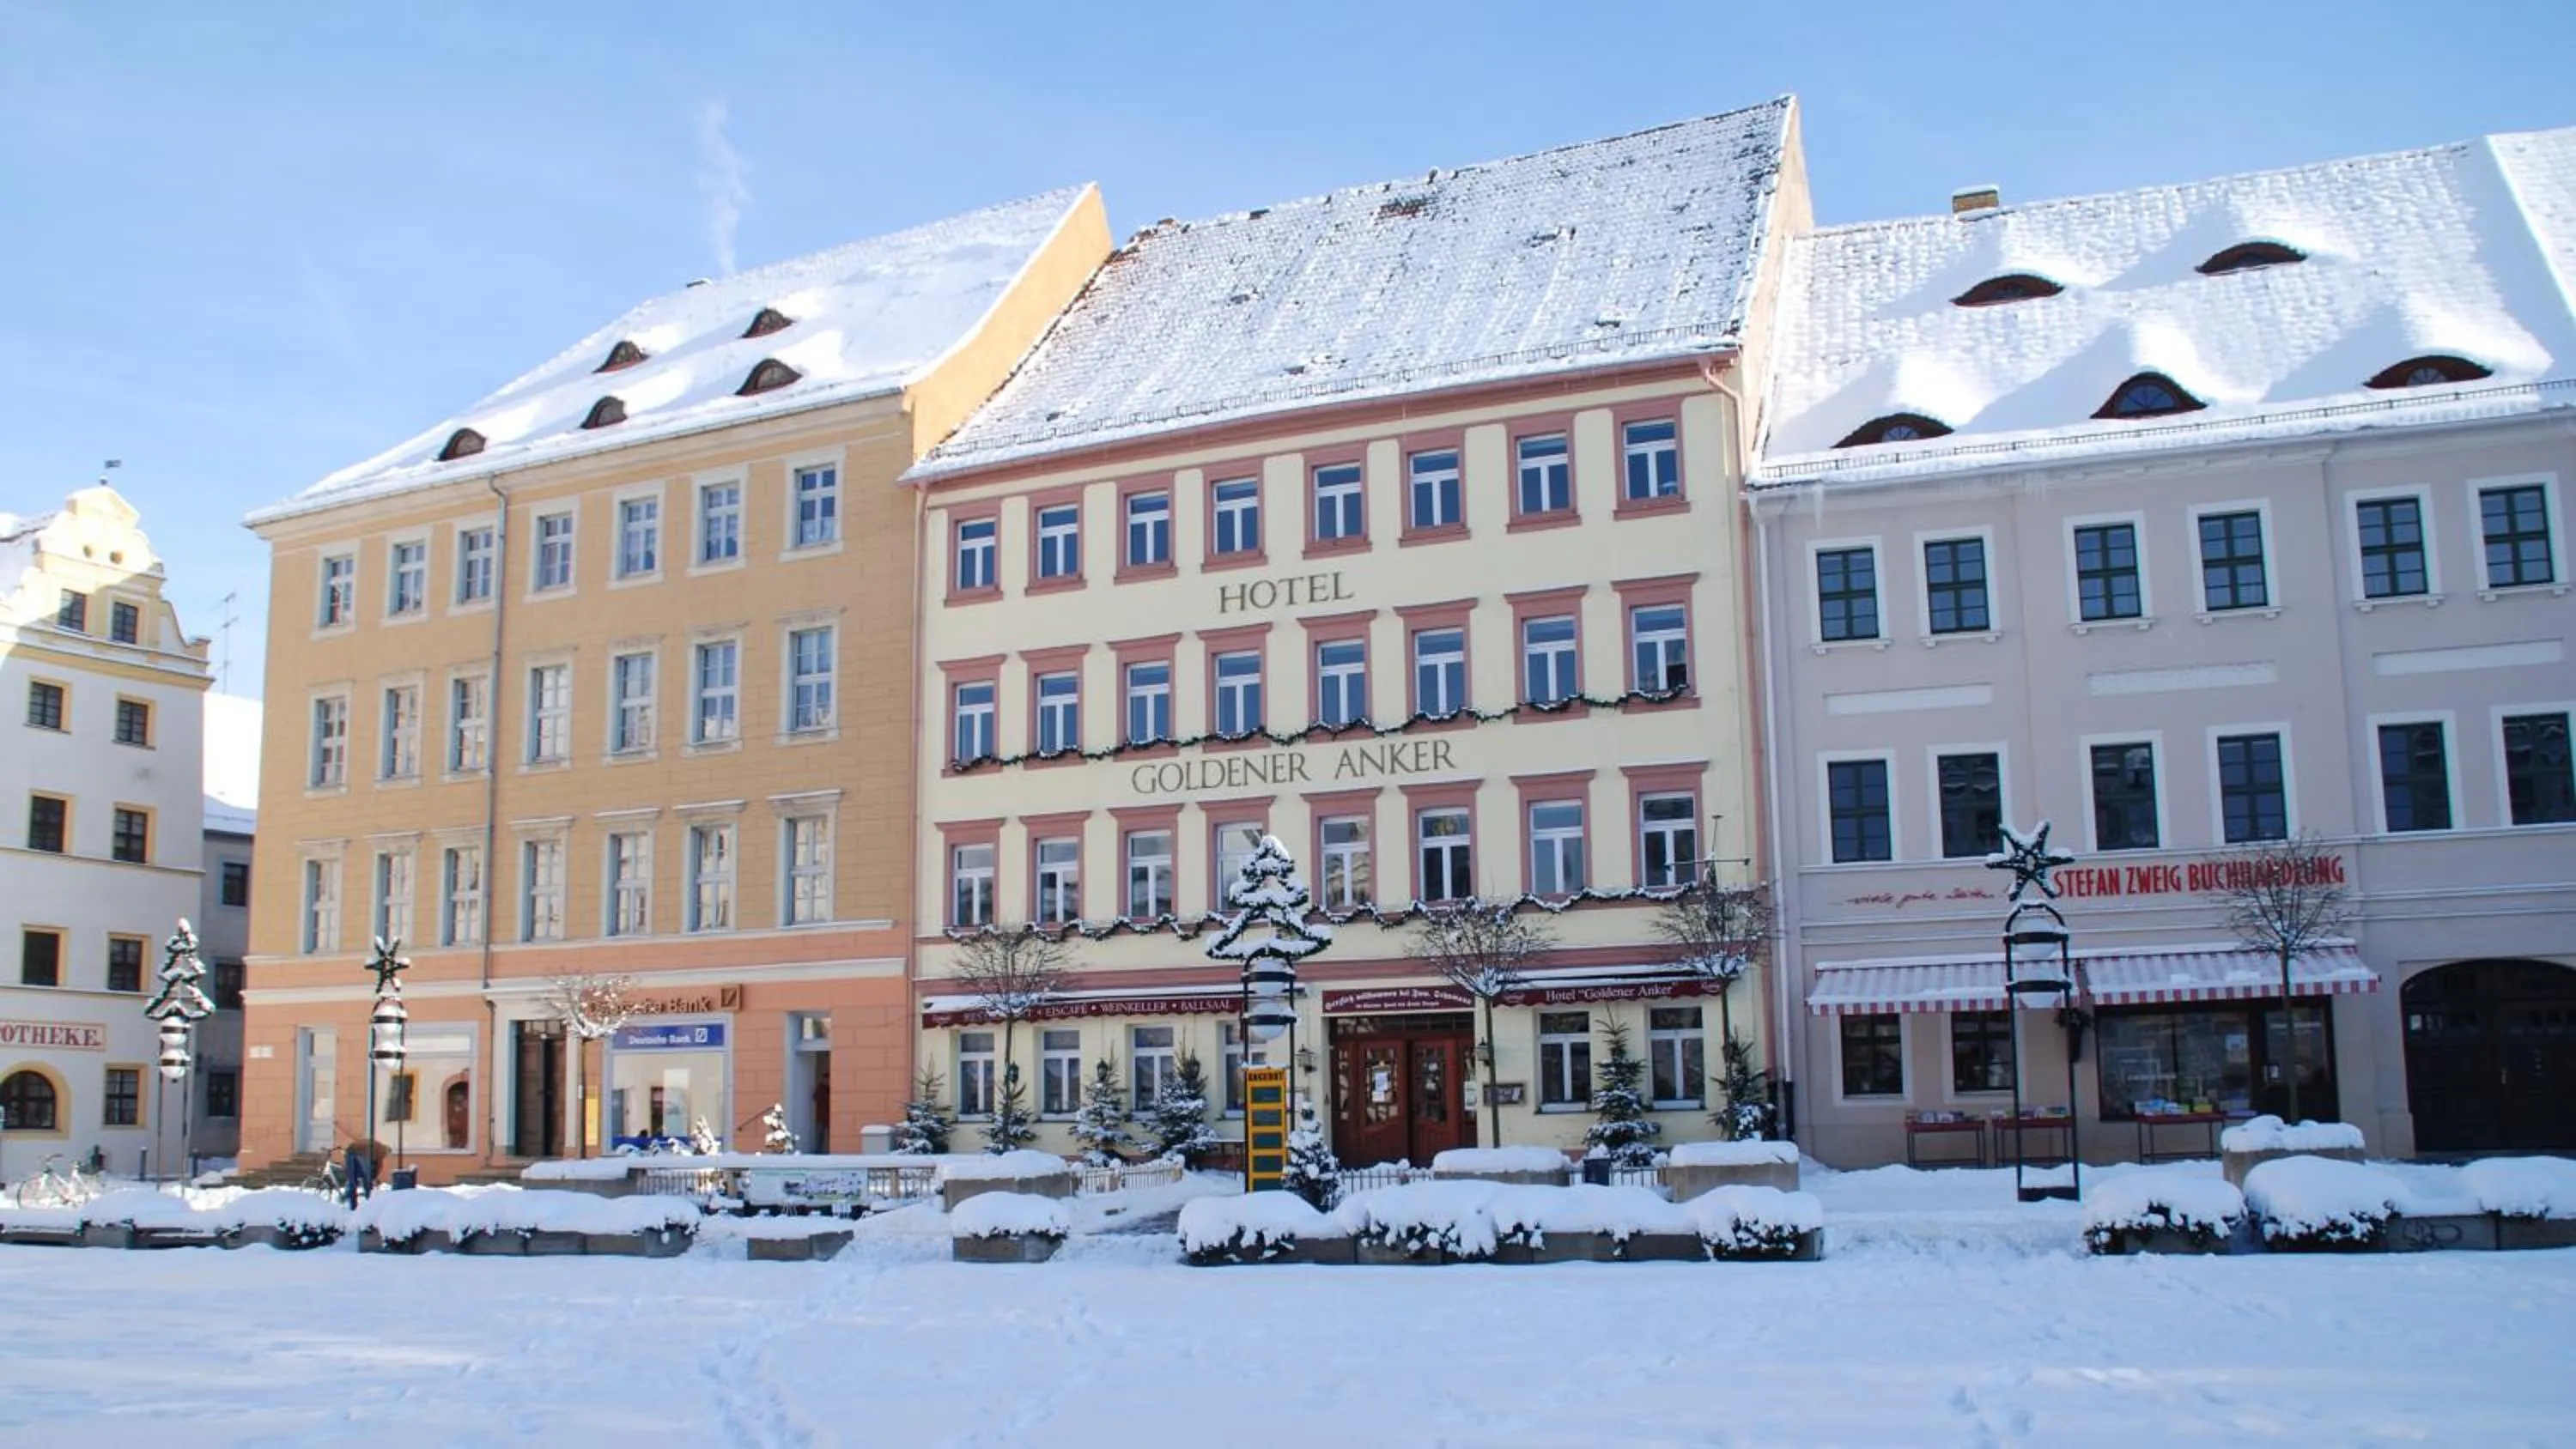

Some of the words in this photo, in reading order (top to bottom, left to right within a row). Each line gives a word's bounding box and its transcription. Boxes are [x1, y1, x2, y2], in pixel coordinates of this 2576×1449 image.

[1218, 572, 1355, 613] HOTEL
[1132, 753, 1310, 794] GOLDENER
[1334, 739, 1456, 779] ANKER
[2053, 866, 2121, 898] STEFAN
[2126, 864, 2182, 894] ZWEIG
[671, 996, 710, 1014] Bank
[1546, 989, 1577, 1003] Hotel
[1100, 999, 1169, 1014] WEINKELLER
[1180, 997, 1232, 1012] BALLSAAL
[629, 1034, 667, 1045] Deutsche
[669, 1034, 691, 1044] Bank
